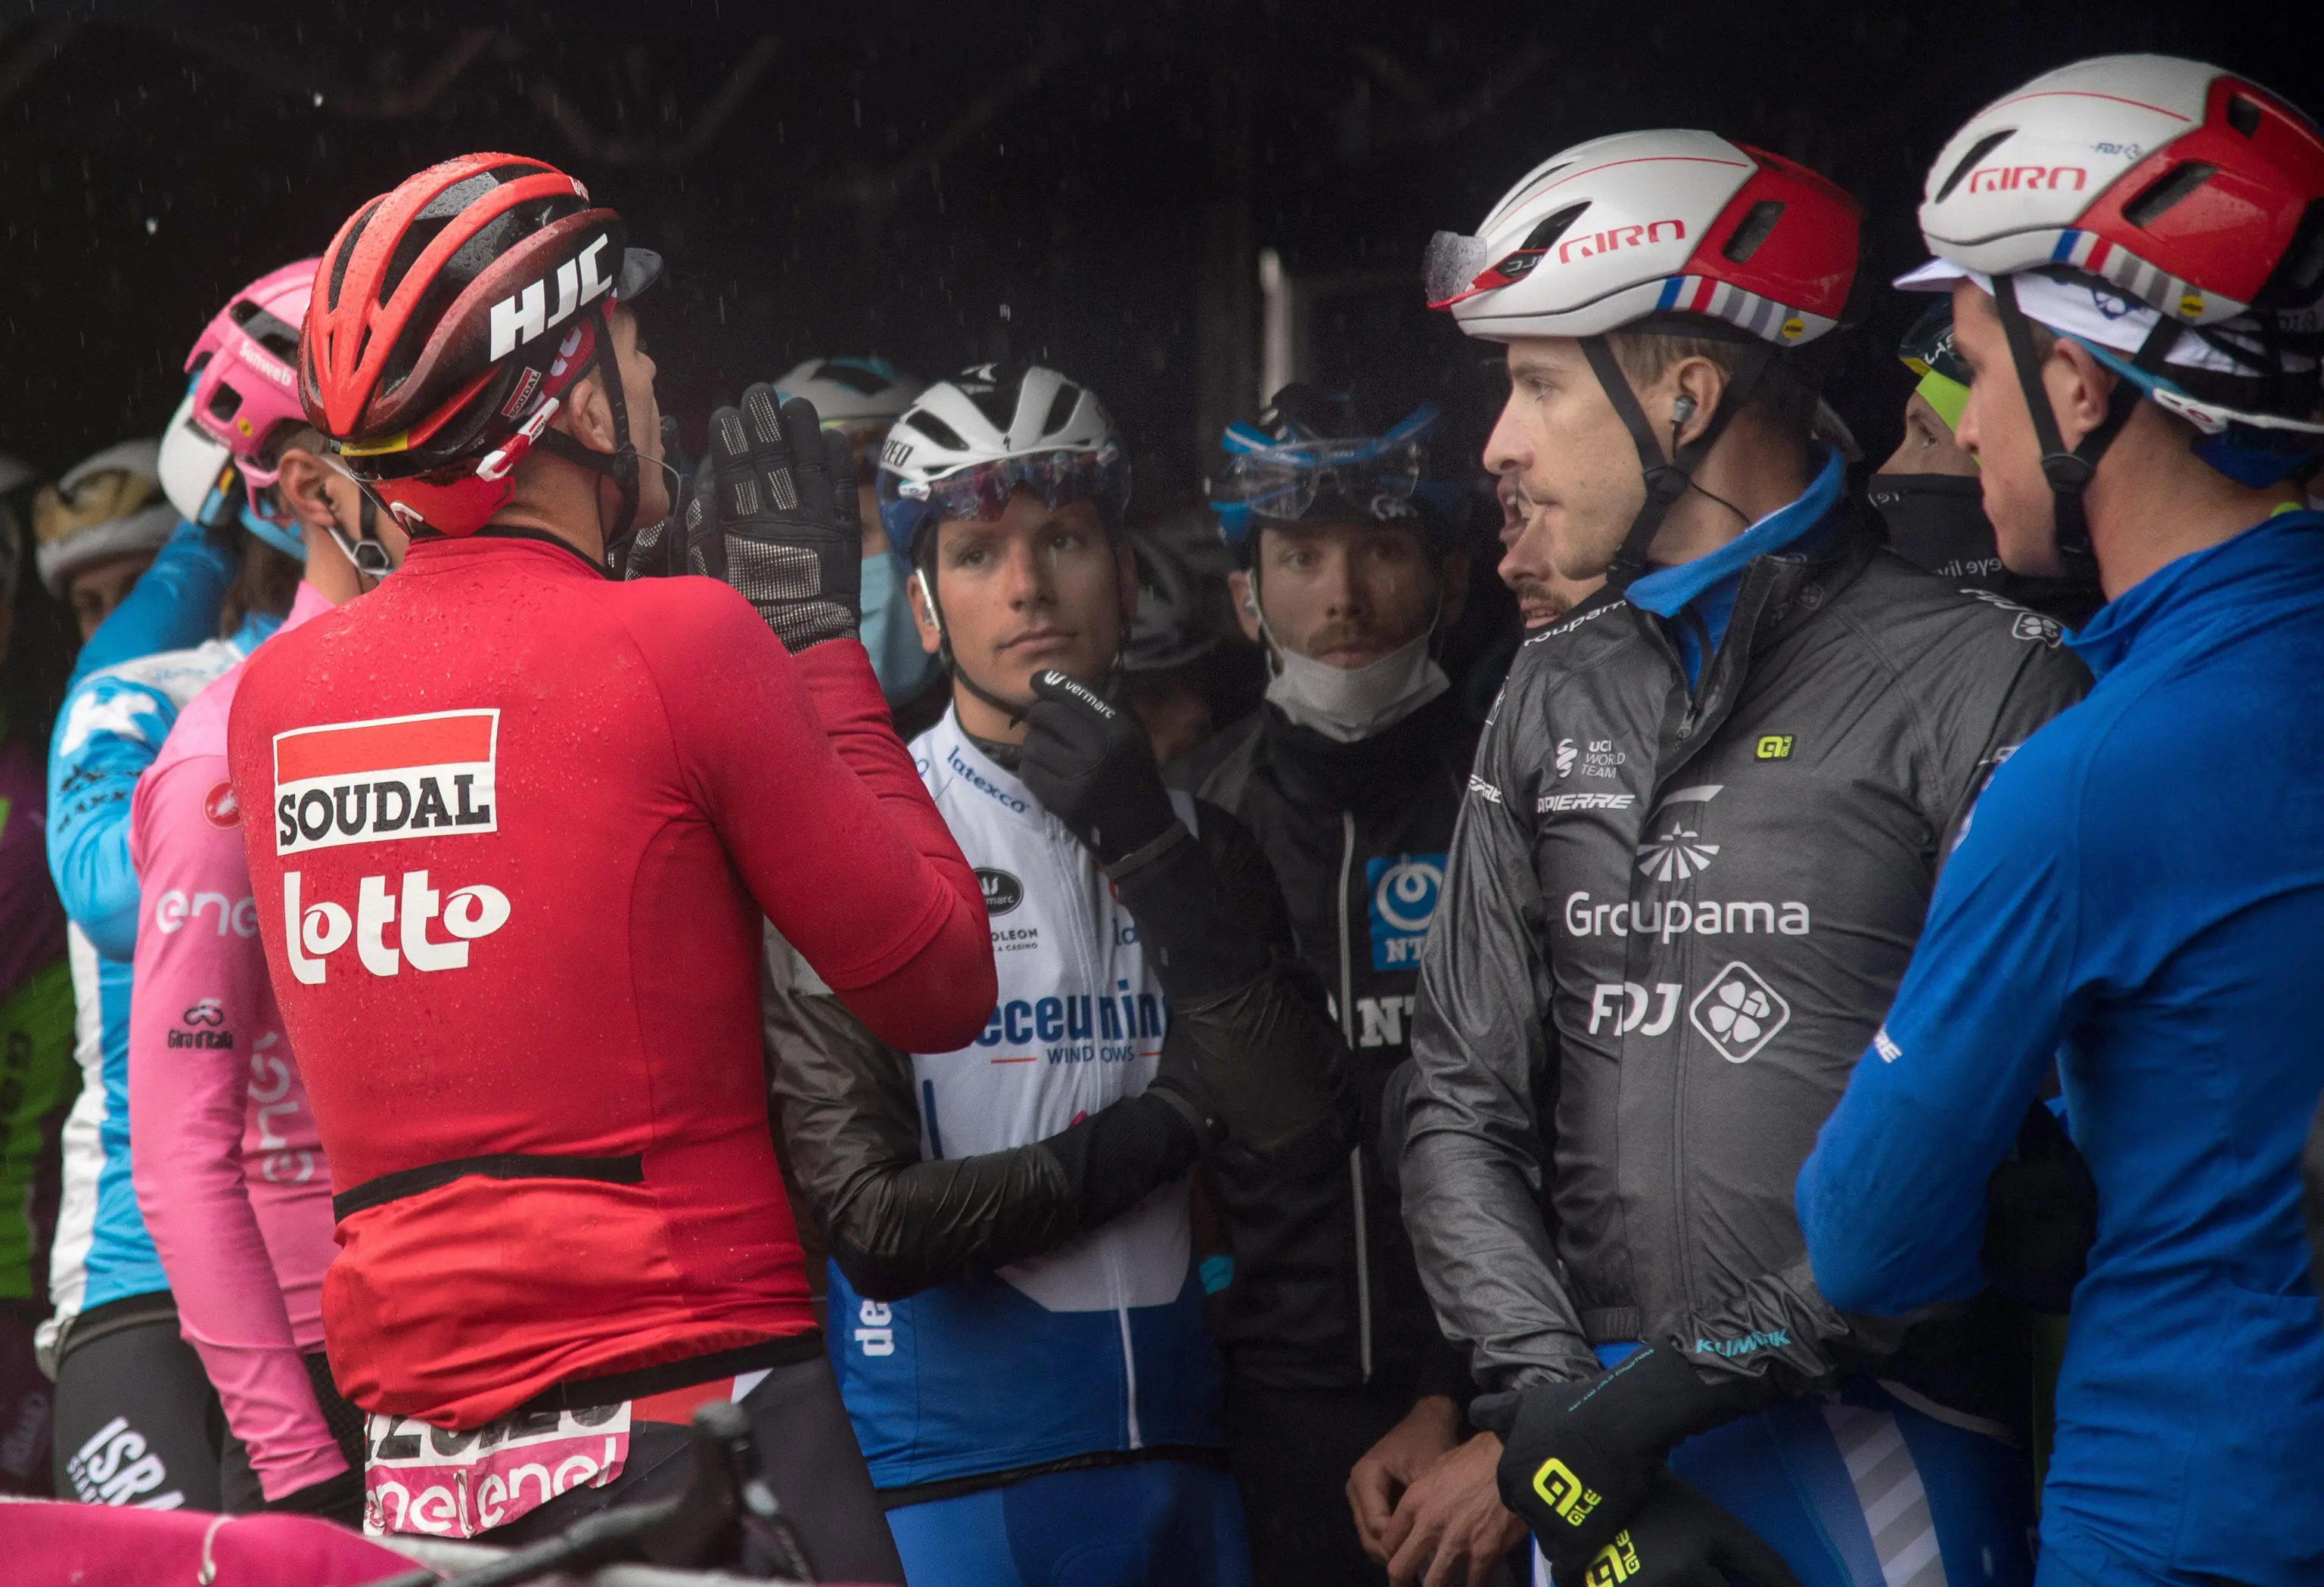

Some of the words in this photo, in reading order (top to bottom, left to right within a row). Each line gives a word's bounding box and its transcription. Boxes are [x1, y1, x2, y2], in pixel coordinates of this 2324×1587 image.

[490, 233, 612, 362] HJC
[239, 339, 292, 387] Sunweb
[508, 372, 540, 418] SOUDAL
[1064, 681, 1116, 719] vermarc
[1585, 753, 1626, 766] WORLD
[1589, 740, 1612, 753] UCI
[947, 745, 1026, 814] latexco
[1581, 764, 1617, 779] TEAM
[278, 774, 491, 846] SOUDAL
[284, 870, 511, 985] lotto
[1565, 892, 1810, 944] Groupama
[1005, 943, 1038, 952] CASINO
[1589, 981, 1682, 1036] FDJ
